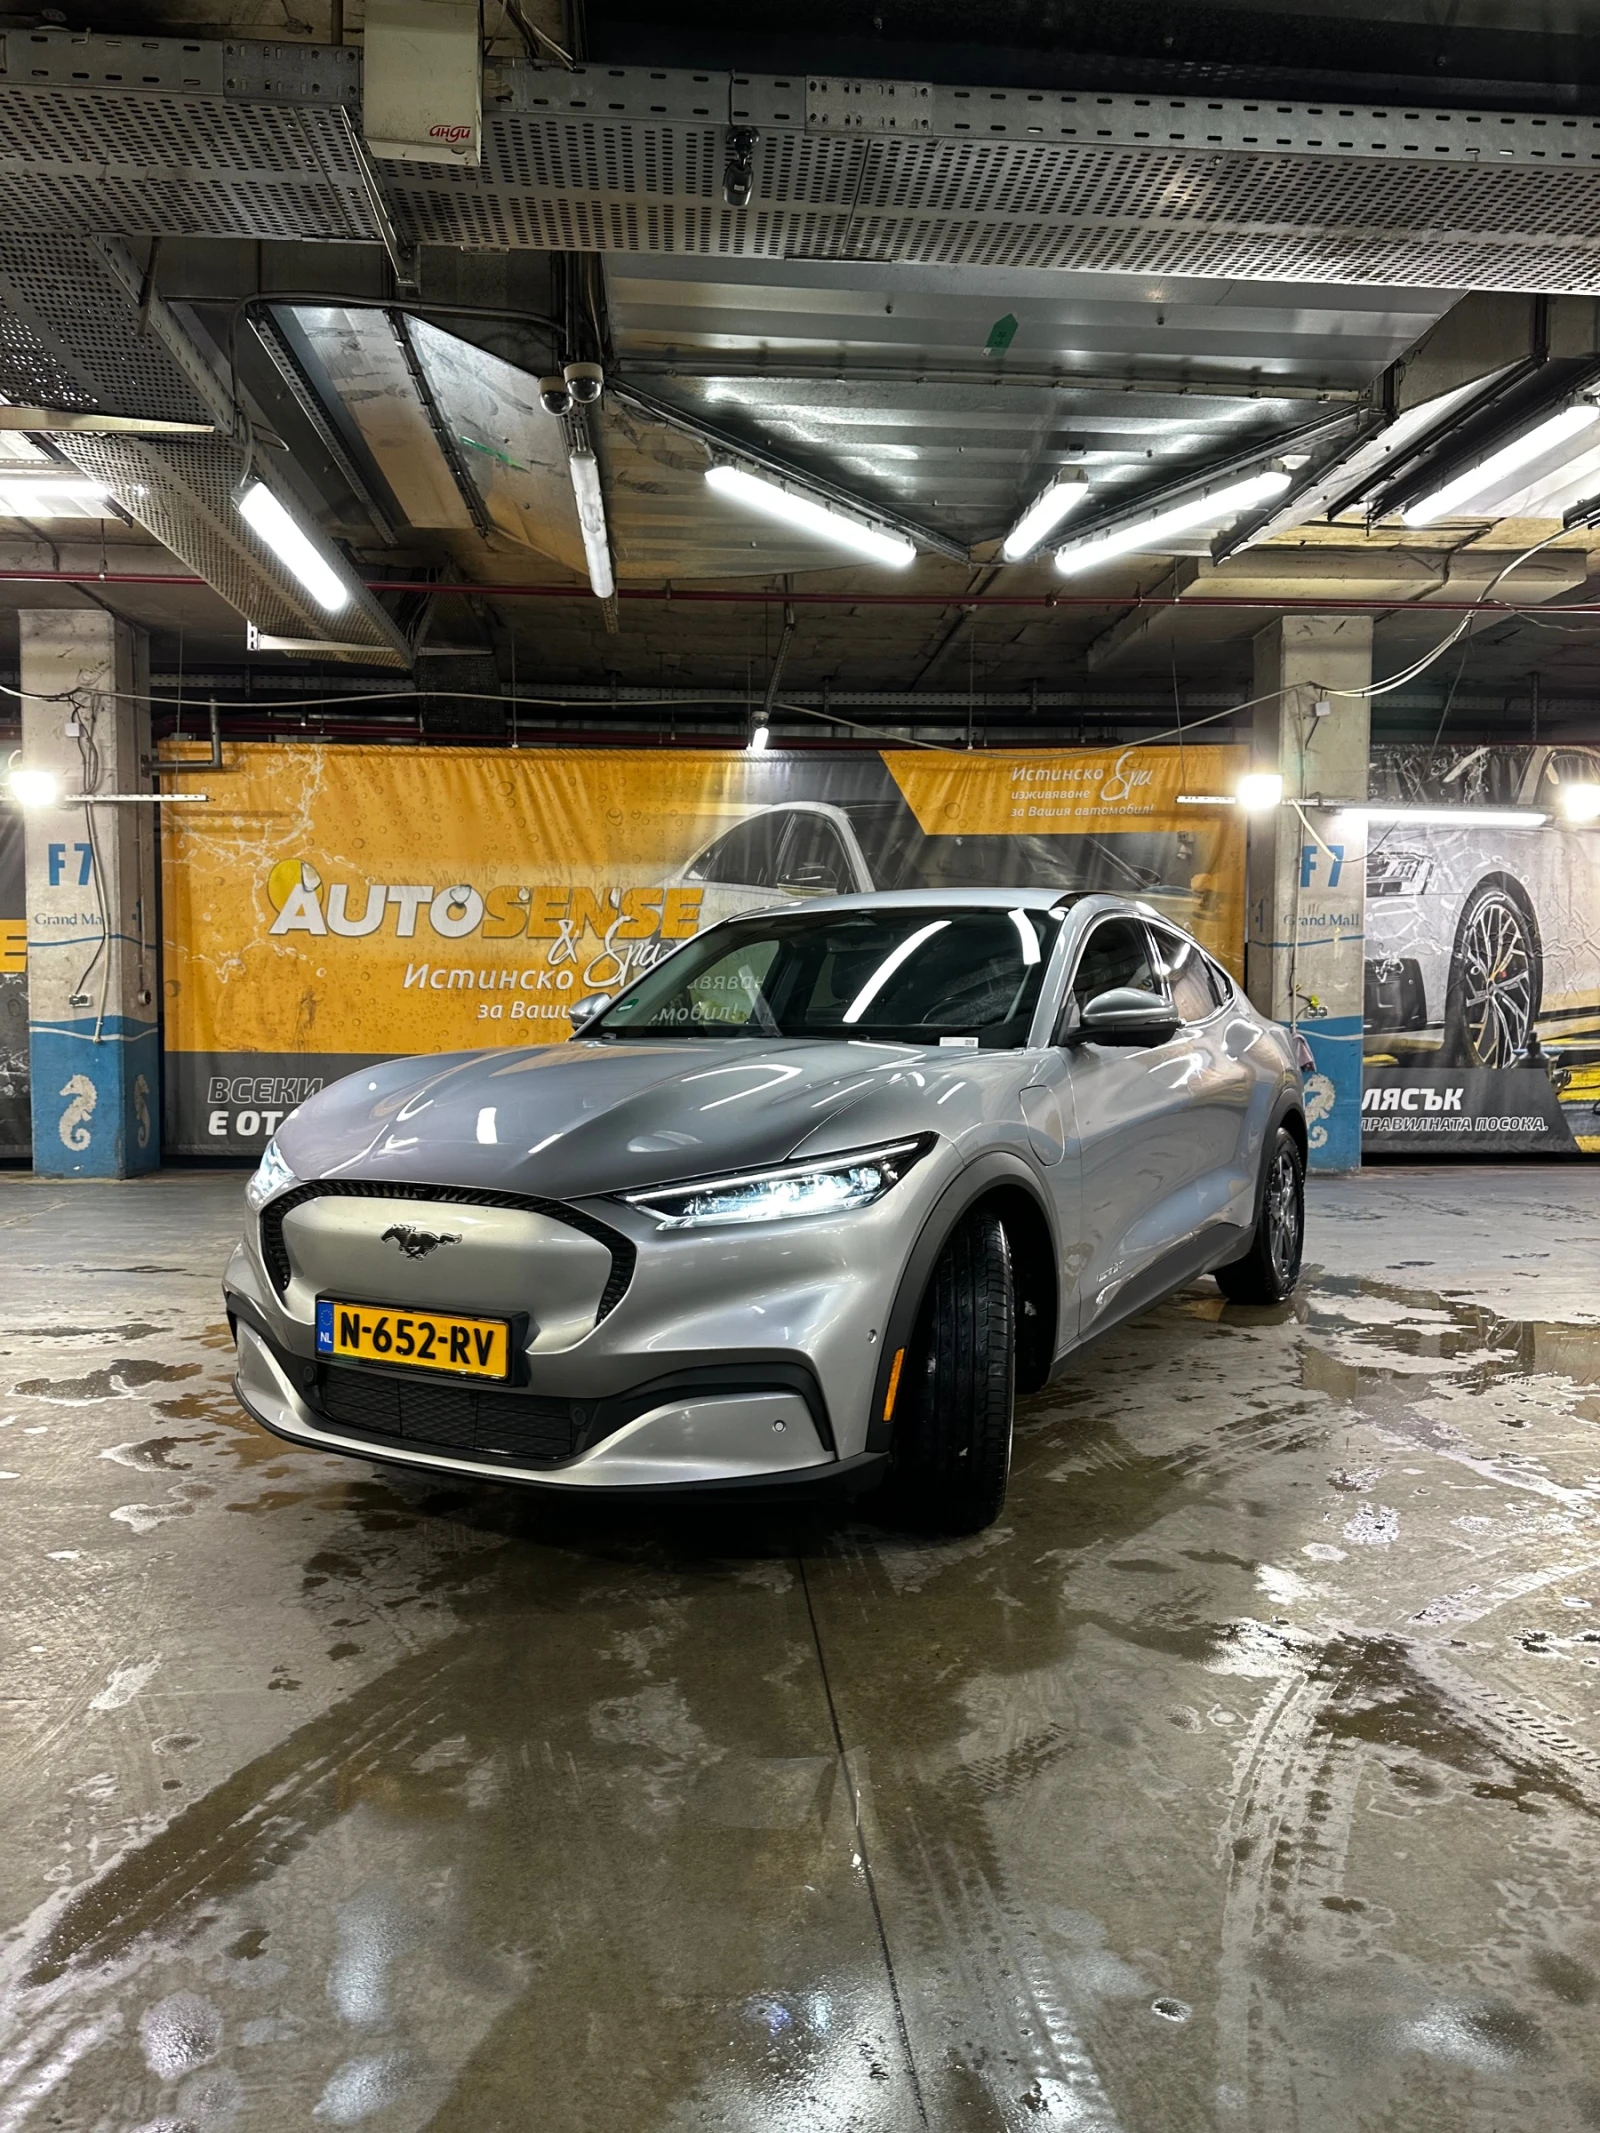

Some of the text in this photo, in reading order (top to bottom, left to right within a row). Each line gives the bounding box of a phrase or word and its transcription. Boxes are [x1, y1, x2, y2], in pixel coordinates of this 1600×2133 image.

[1011, 766, 1104, 782] Истинско
[1011, 789, 1091, 800] изживяване
[1010, 803, 1155, 817] за Вашия автомобил!
[268, 882, 703, 939] AUTOSENSE
[34, 912, 112, 926] Grand Mal
[1329, 913, 1360, 926] Mall
[547, 915, 662, 988] & Spa
[402, 962, 574, 991] Истинско
[477, 1004, 504, 1020] за
[207, 1076, 324, 1104] ВСЕКИ
[208, 1110, 284, 1136] Е ОТ
[1474, 1116, 1549, 1132] ПОСОКА.
[320, 1311, 495, 1367] NL N-652-RV
